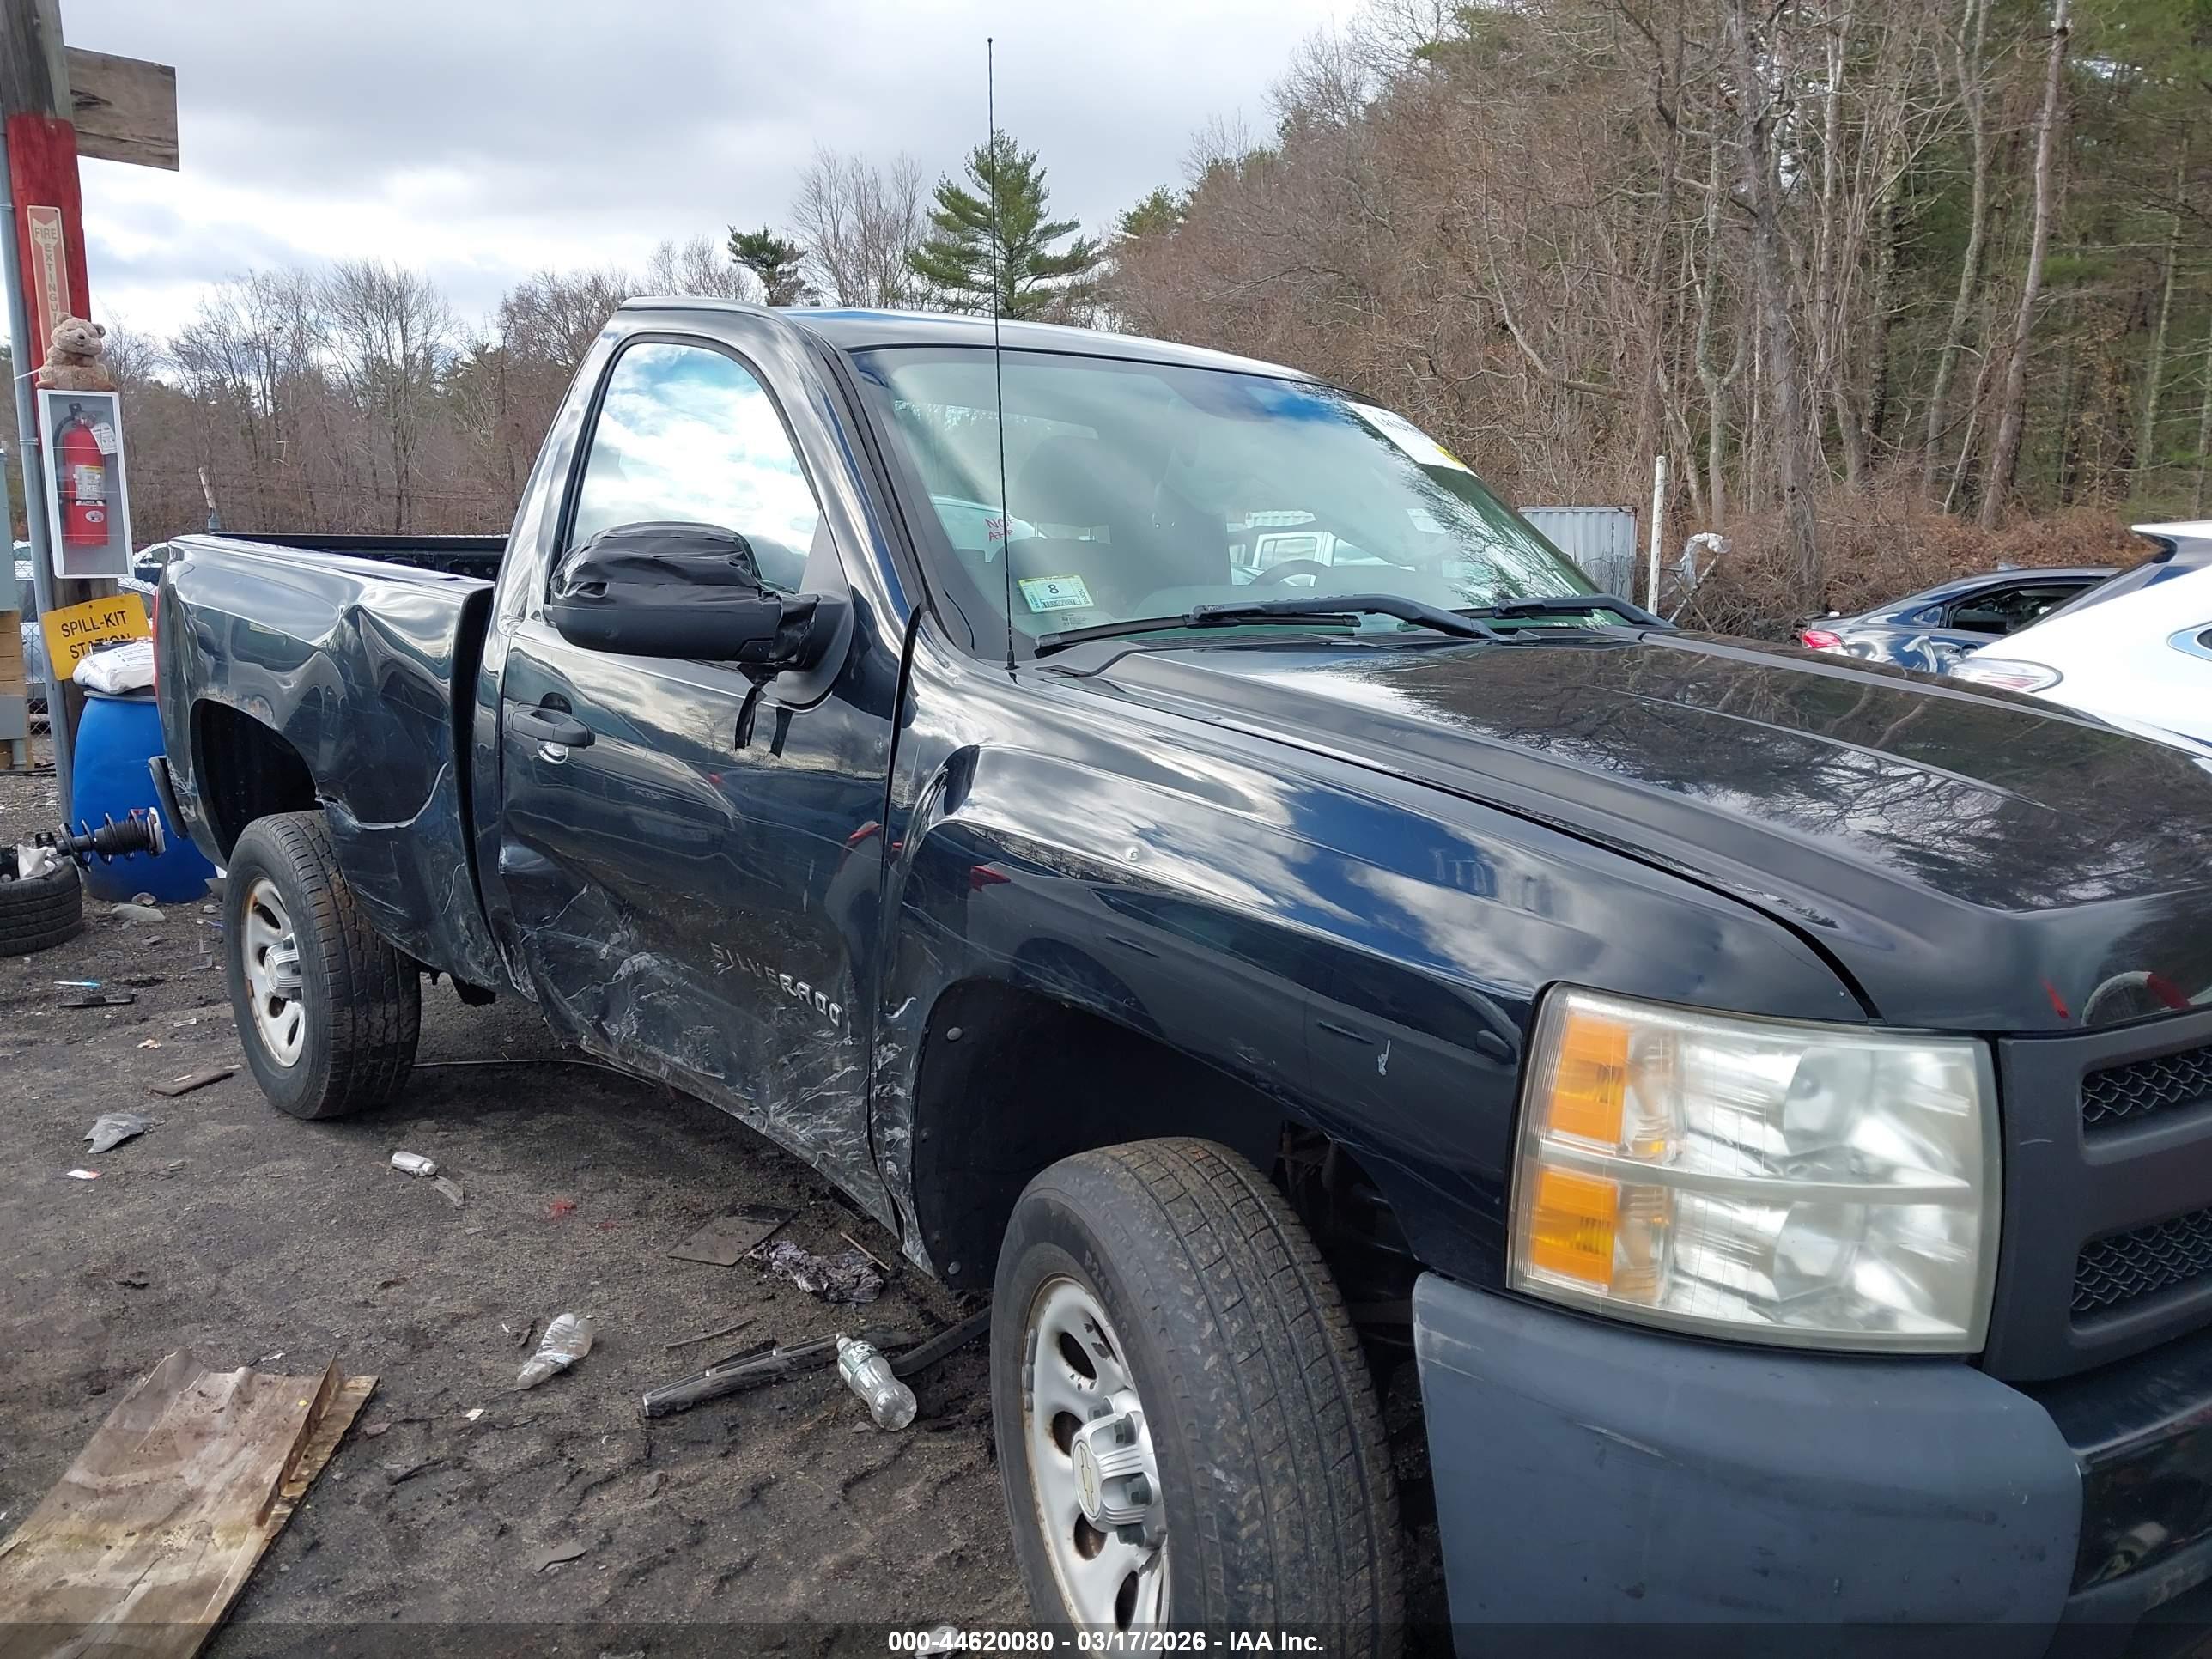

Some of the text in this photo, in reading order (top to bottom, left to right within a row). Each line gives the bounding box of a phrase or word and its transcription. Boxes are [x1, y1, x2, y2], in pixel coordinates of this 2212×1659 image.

[34, 227, 58, 240] FIRE
[45, 243, 59, 328] EXTINGUI
[1048, 584, 1060, 594] 8
[61, 611, 127, 637] SPILL-KIT
[710, 942, 843, 1027] SILVERADO
